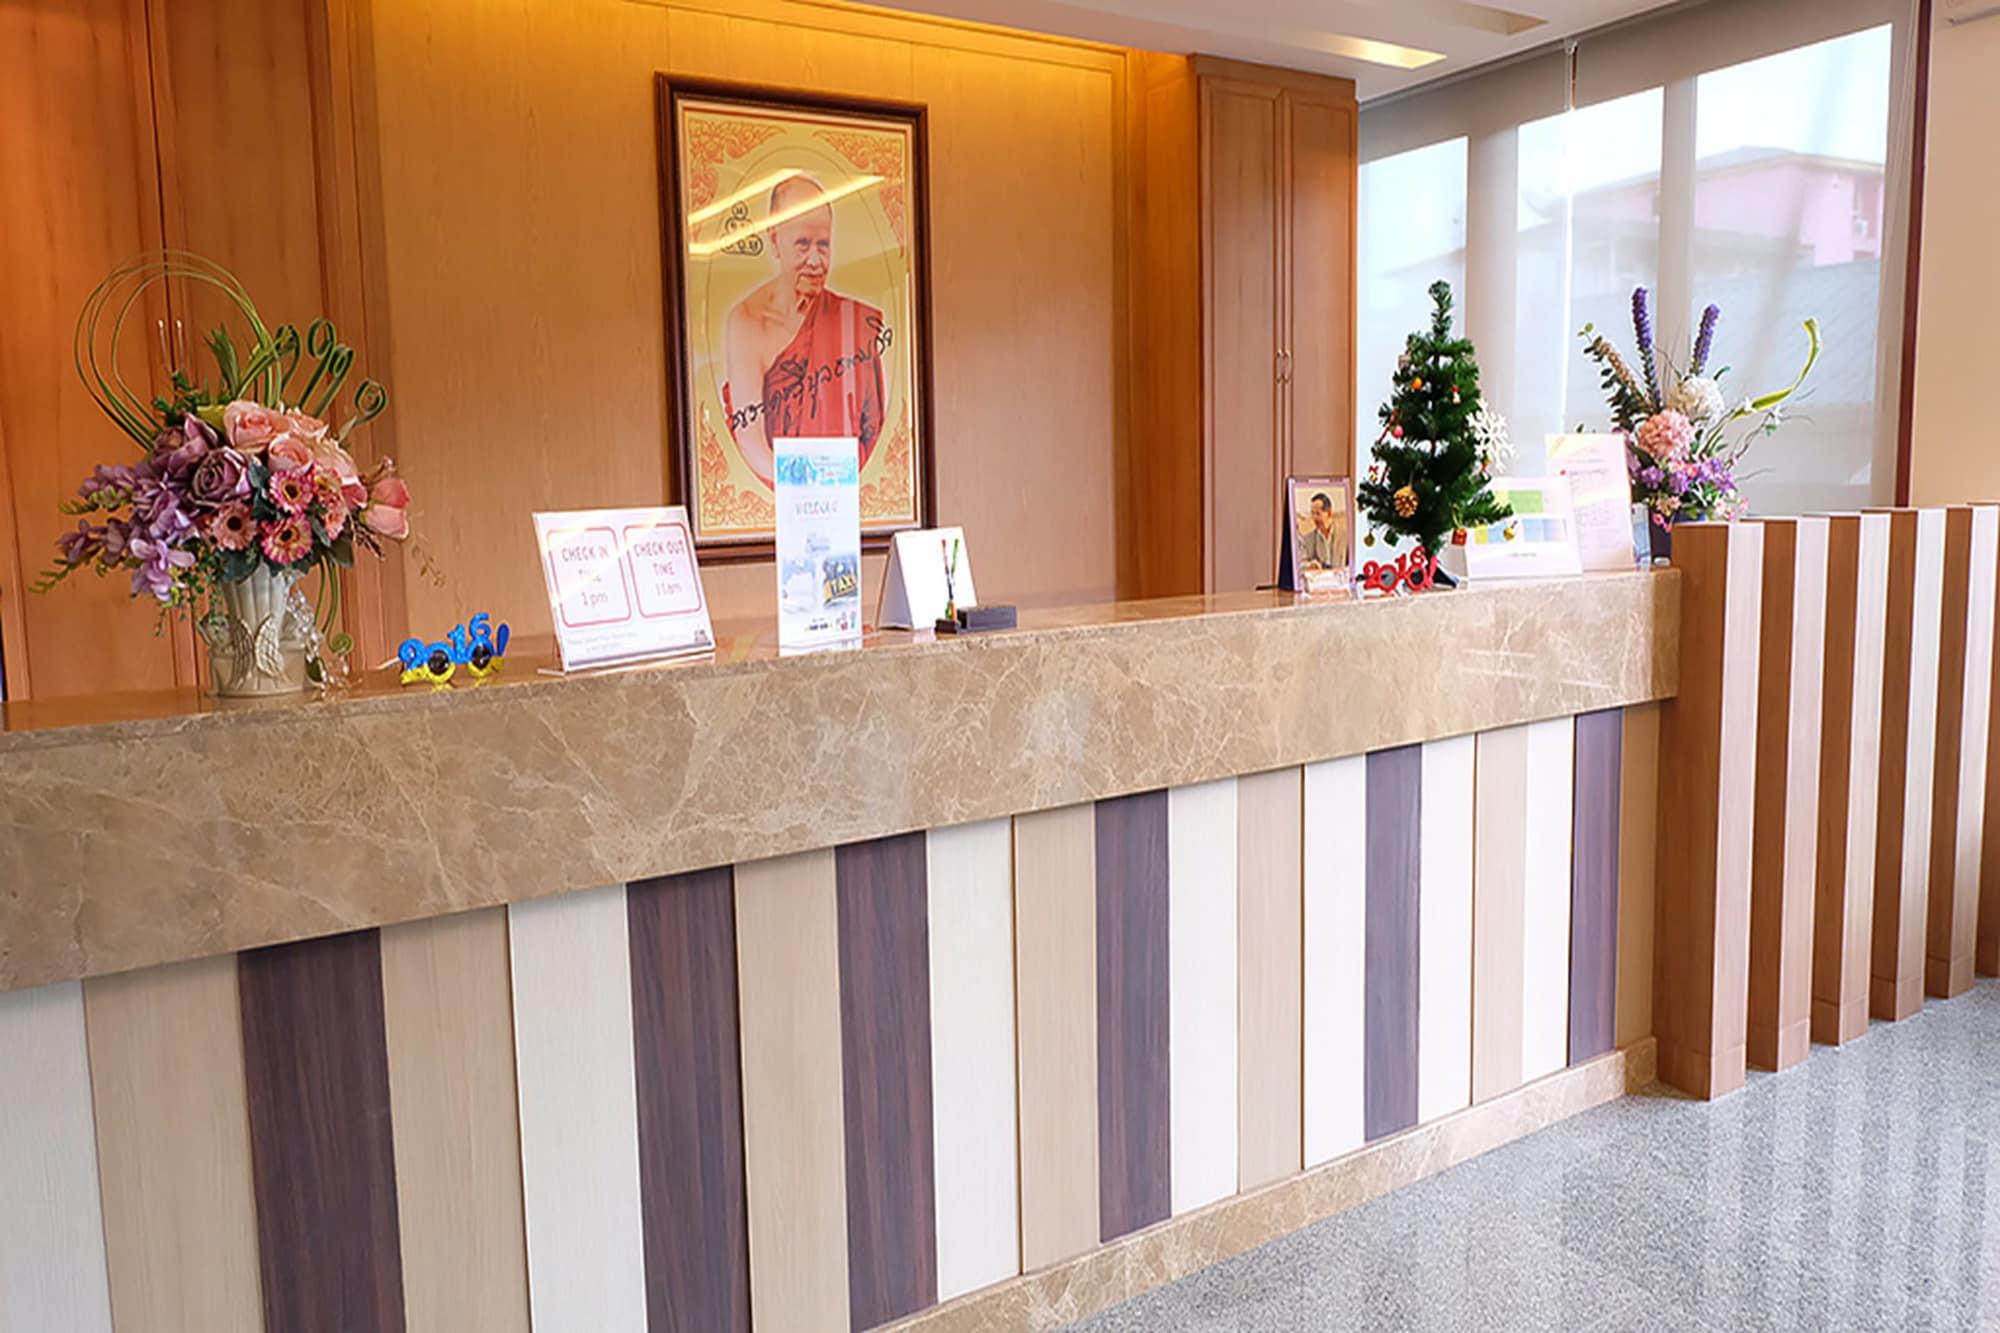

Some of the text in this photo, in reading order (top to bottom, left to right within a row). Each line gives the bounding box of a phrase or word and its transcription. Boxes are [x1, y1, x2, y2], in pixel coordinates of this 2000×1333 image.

[561, 545, 595, 562] CHECK
[633, 539, 685, 557] CHECK OUT
[653, 561, 675, 577] TIME
